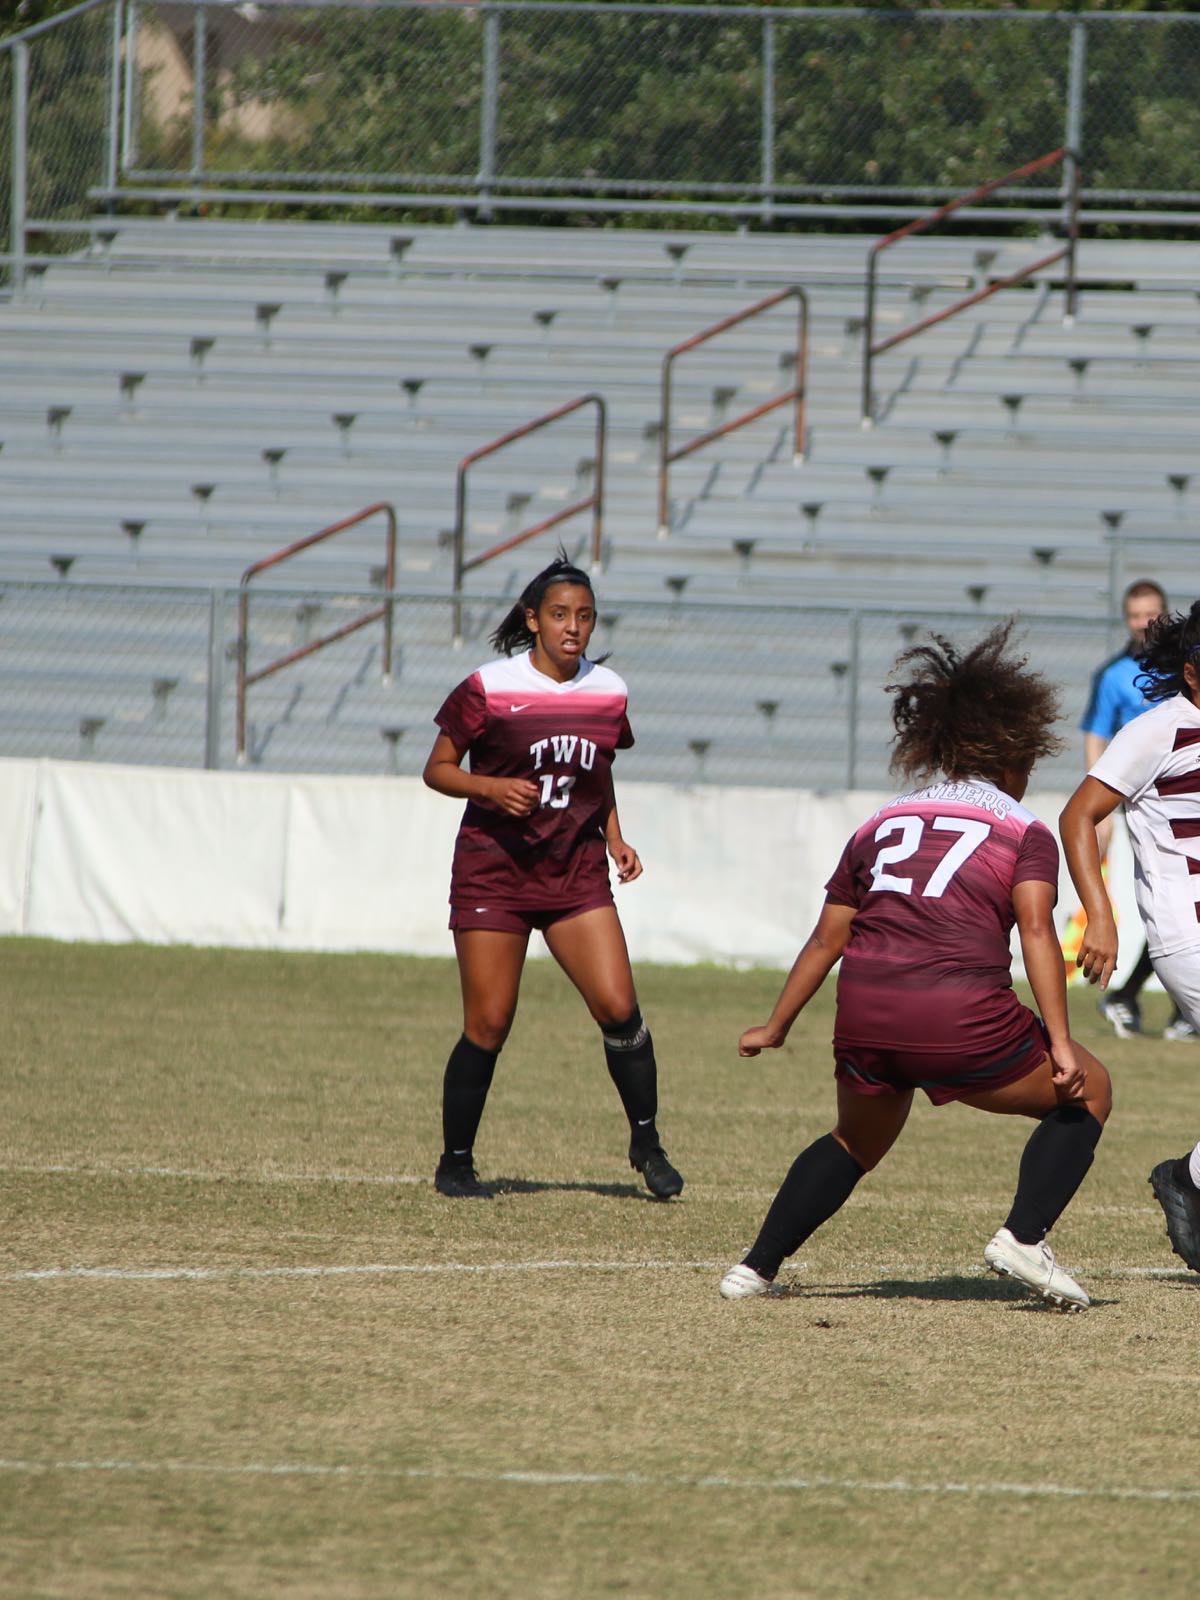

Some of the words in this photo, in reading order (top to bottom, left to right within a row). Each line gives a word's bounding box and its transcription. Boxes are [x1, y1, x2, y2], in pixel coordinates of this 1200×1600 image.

[529, 735, 597, 770] TWU
[539, 774, 576, 808] 13
[869, 815, 992, 898] 27
